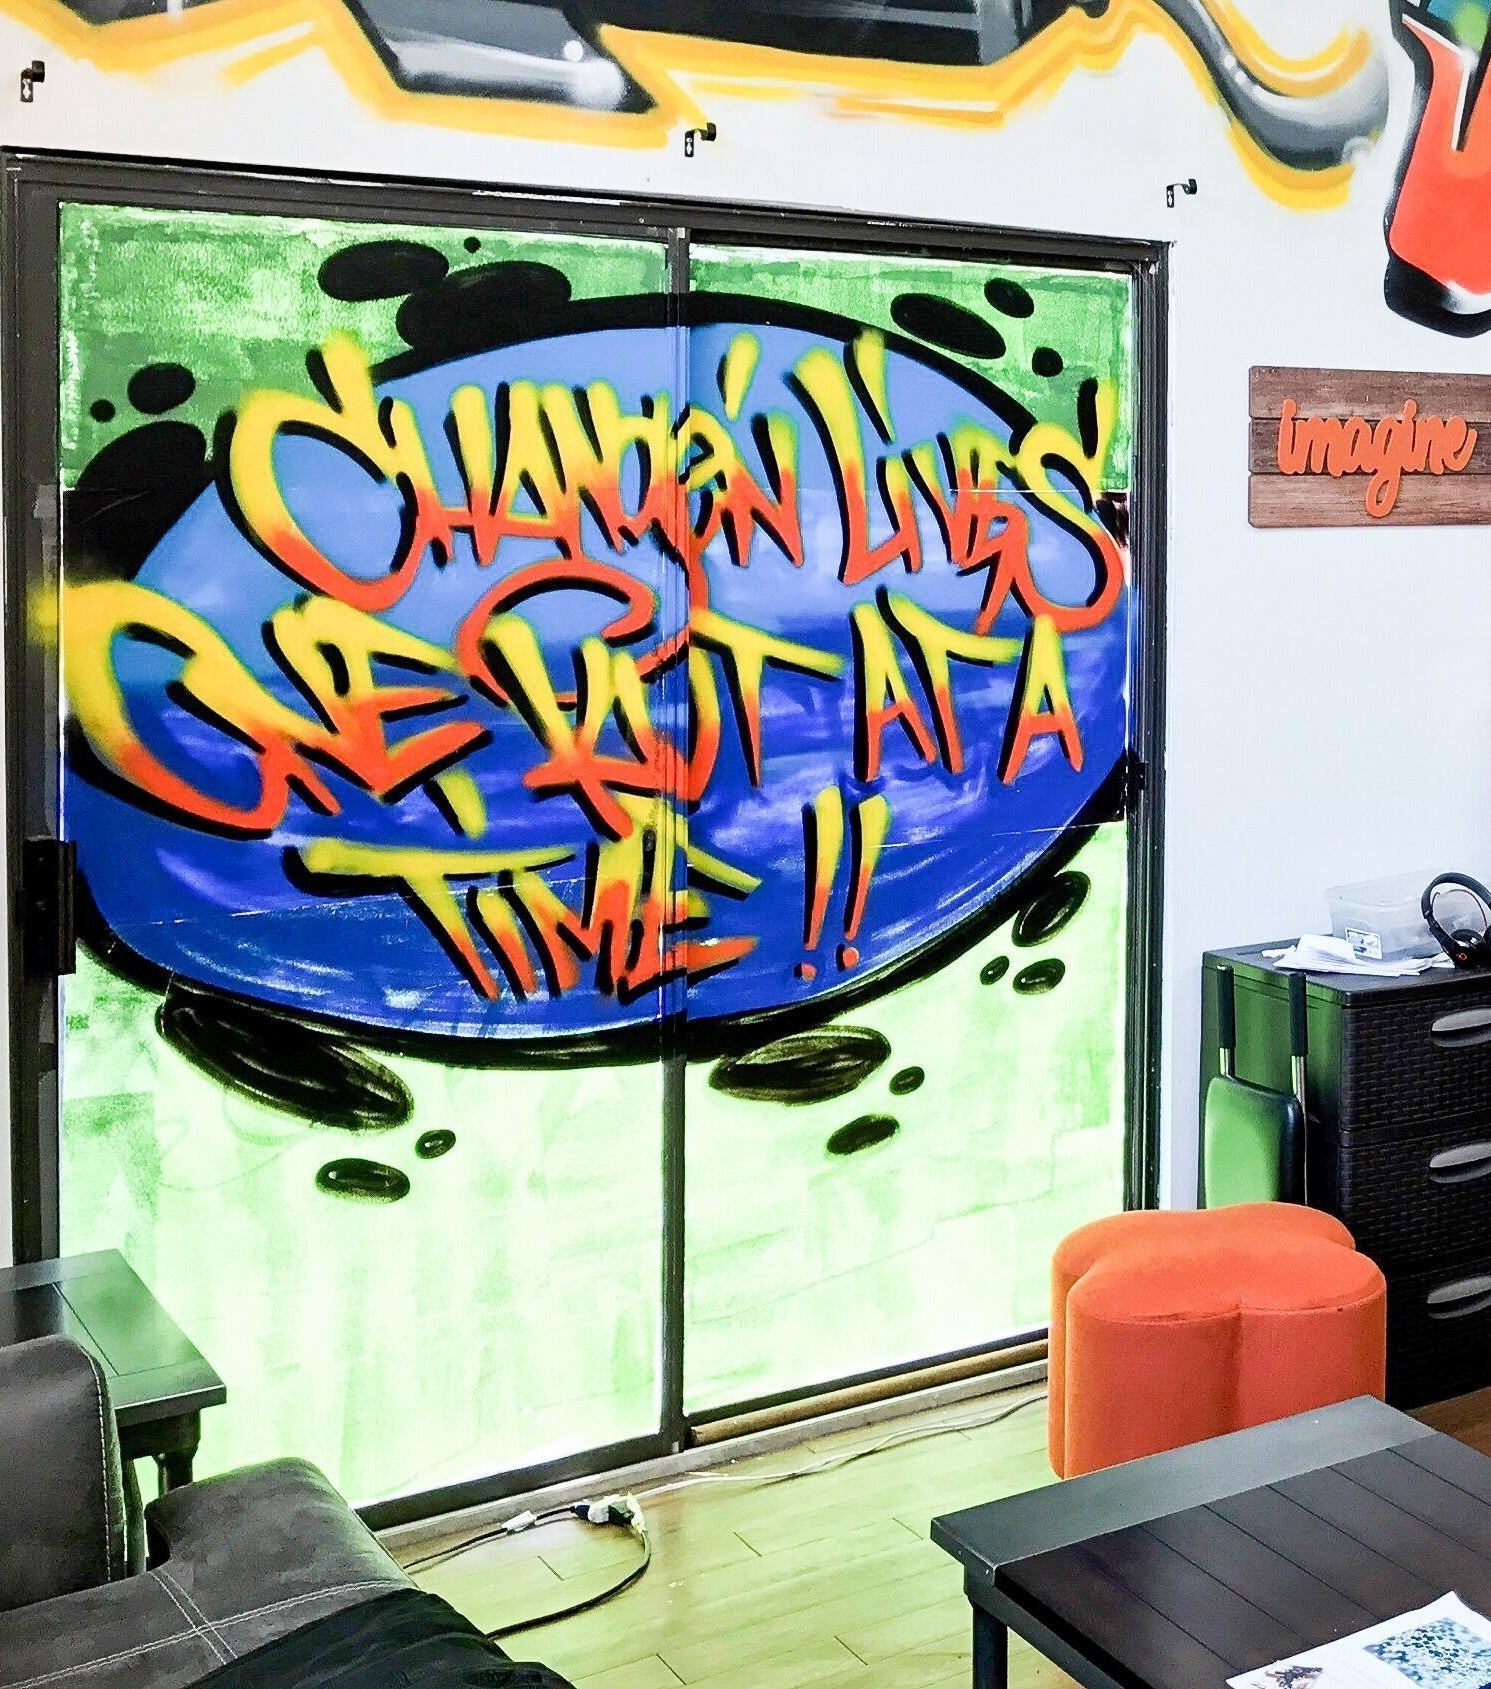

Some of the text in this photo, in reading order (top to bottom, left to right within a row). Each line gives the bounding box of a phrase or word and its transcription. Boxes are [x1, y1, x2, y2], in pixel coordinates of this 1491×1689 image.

[1277, 399, 1478, 518] imagine
[852, 590, 1024, 785] AT
[998, 612, 1086, 786] A
[283, 778, 765, 1000] TIME
